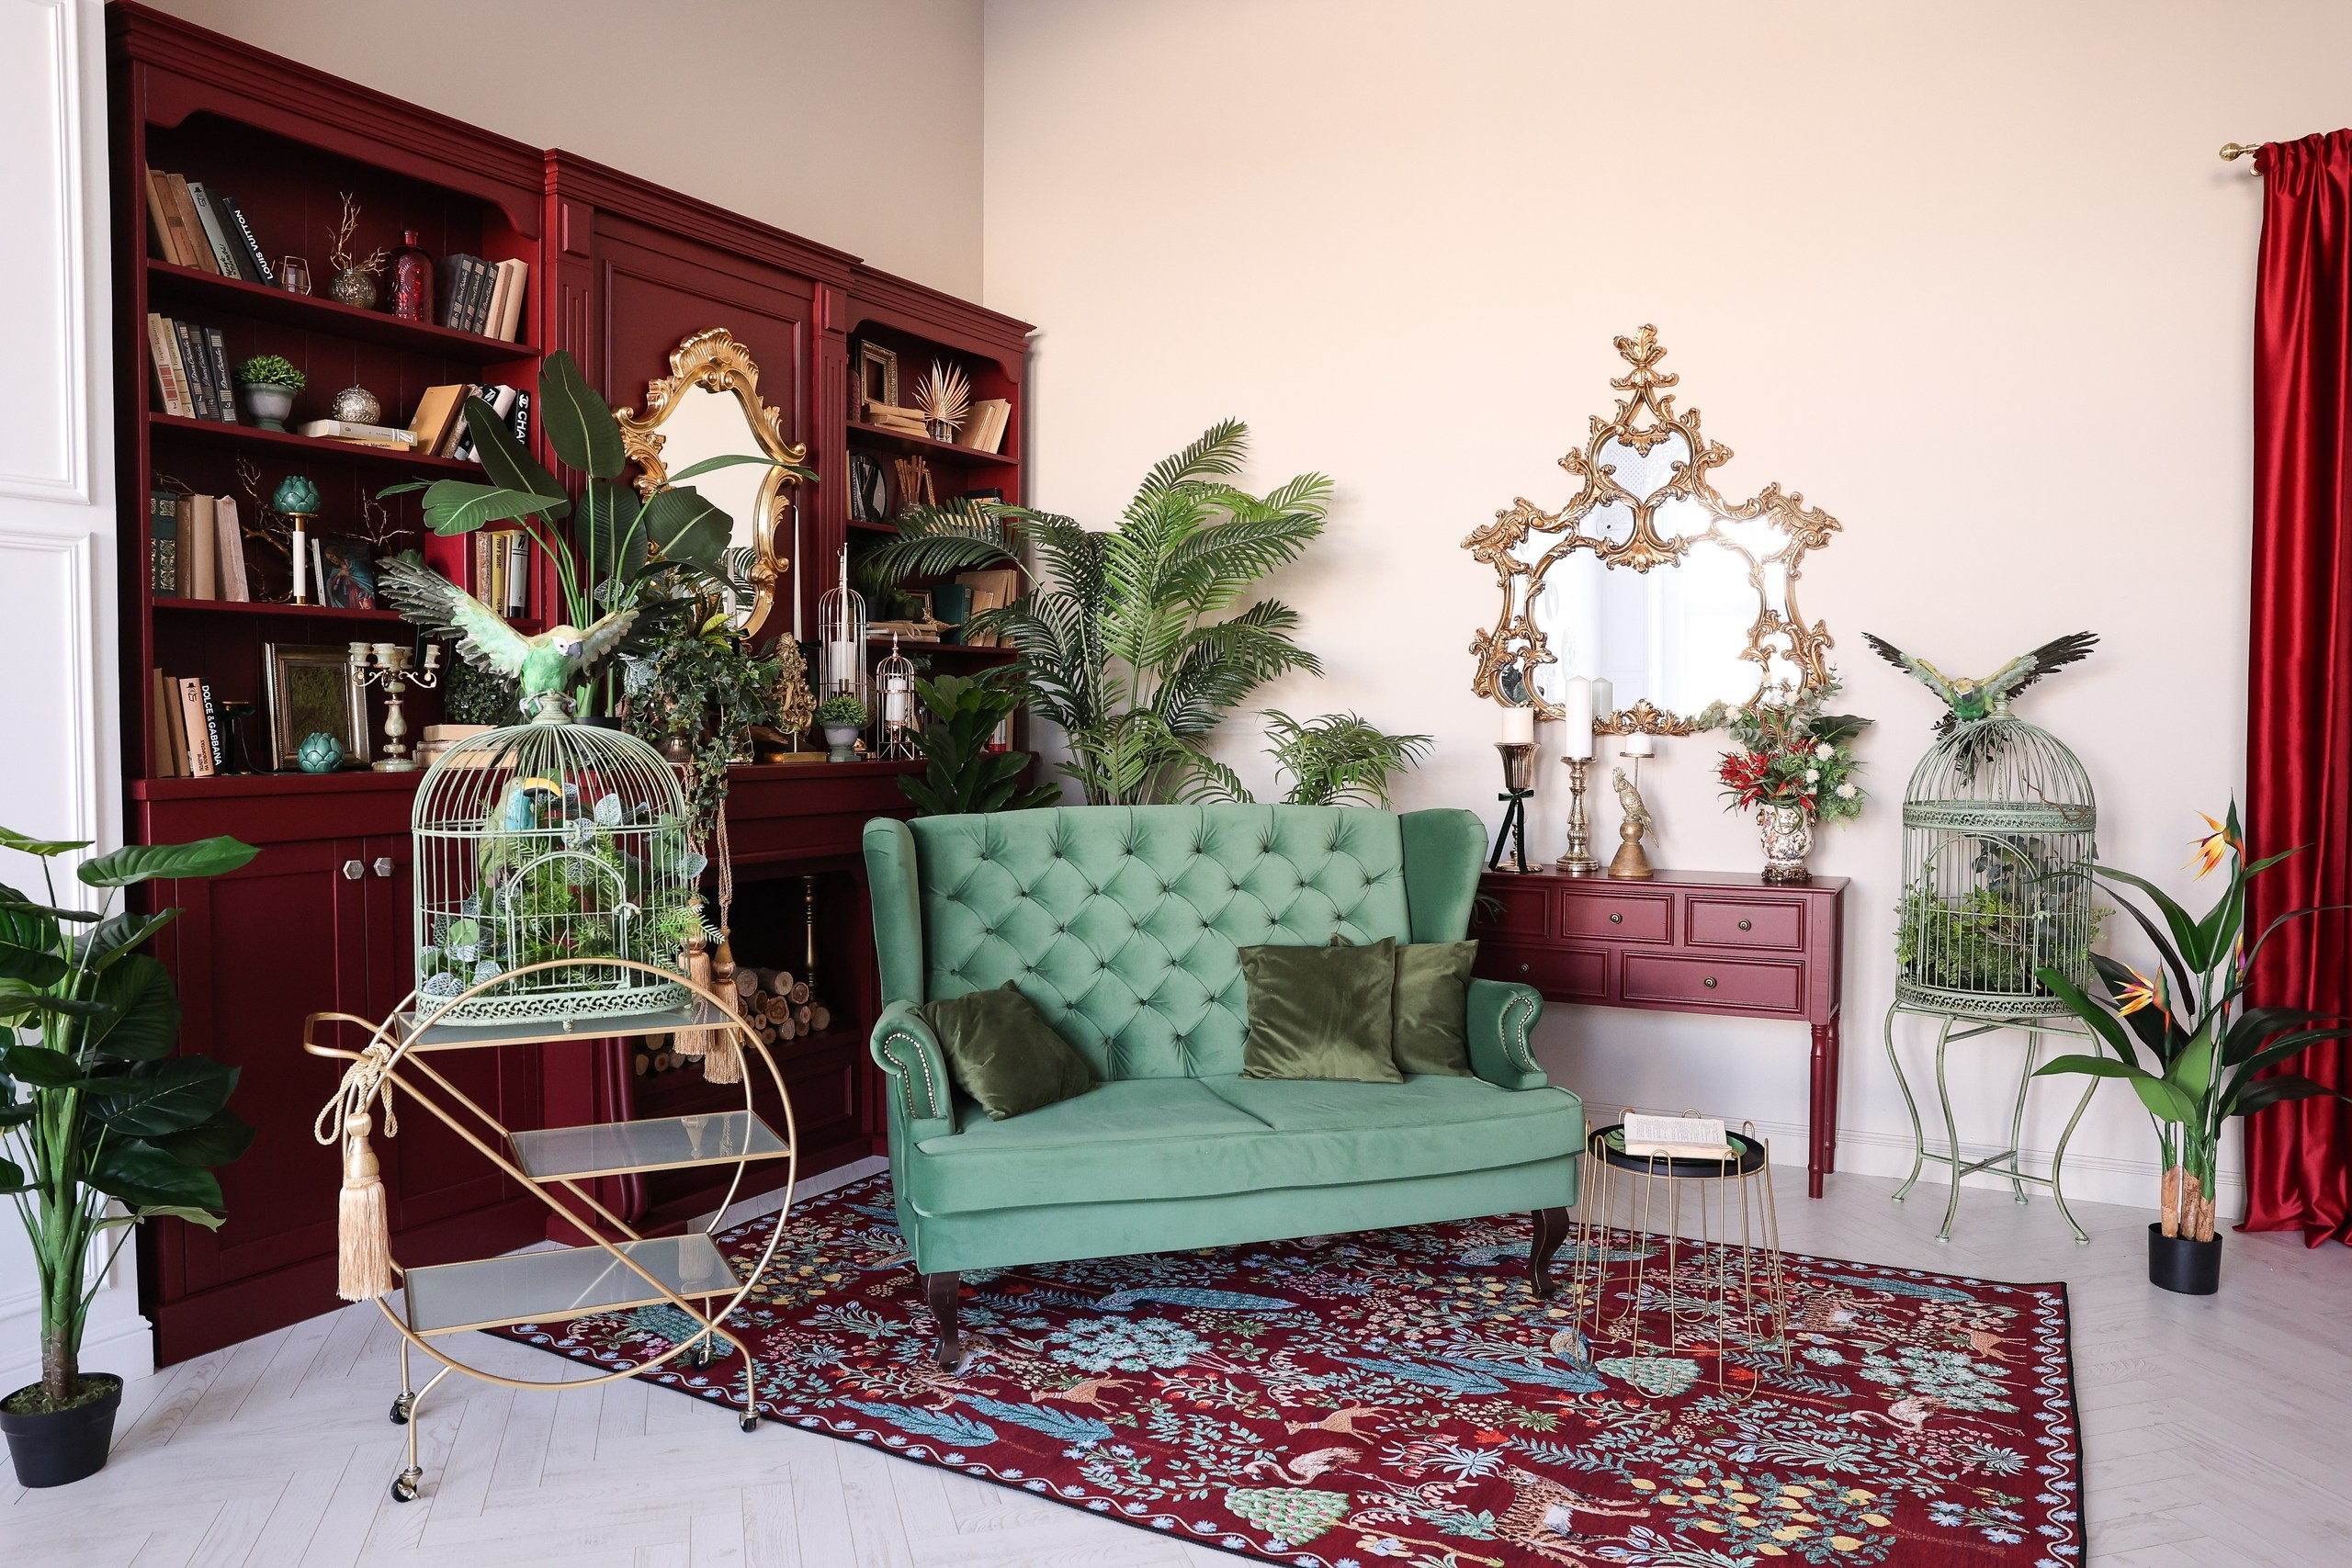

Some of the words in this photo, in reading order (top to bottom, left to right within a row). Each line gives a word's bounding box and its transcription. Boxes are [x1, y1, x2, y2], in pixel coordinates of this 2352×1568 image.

[234, 209, 259, 251] VUITTON
[255, 252, 274, 280] LOUIS
[173, 401, 177, 410] 2
[201, 684, 214, 714] DOLCE
[208, 722, 222, 766] GABBANA
